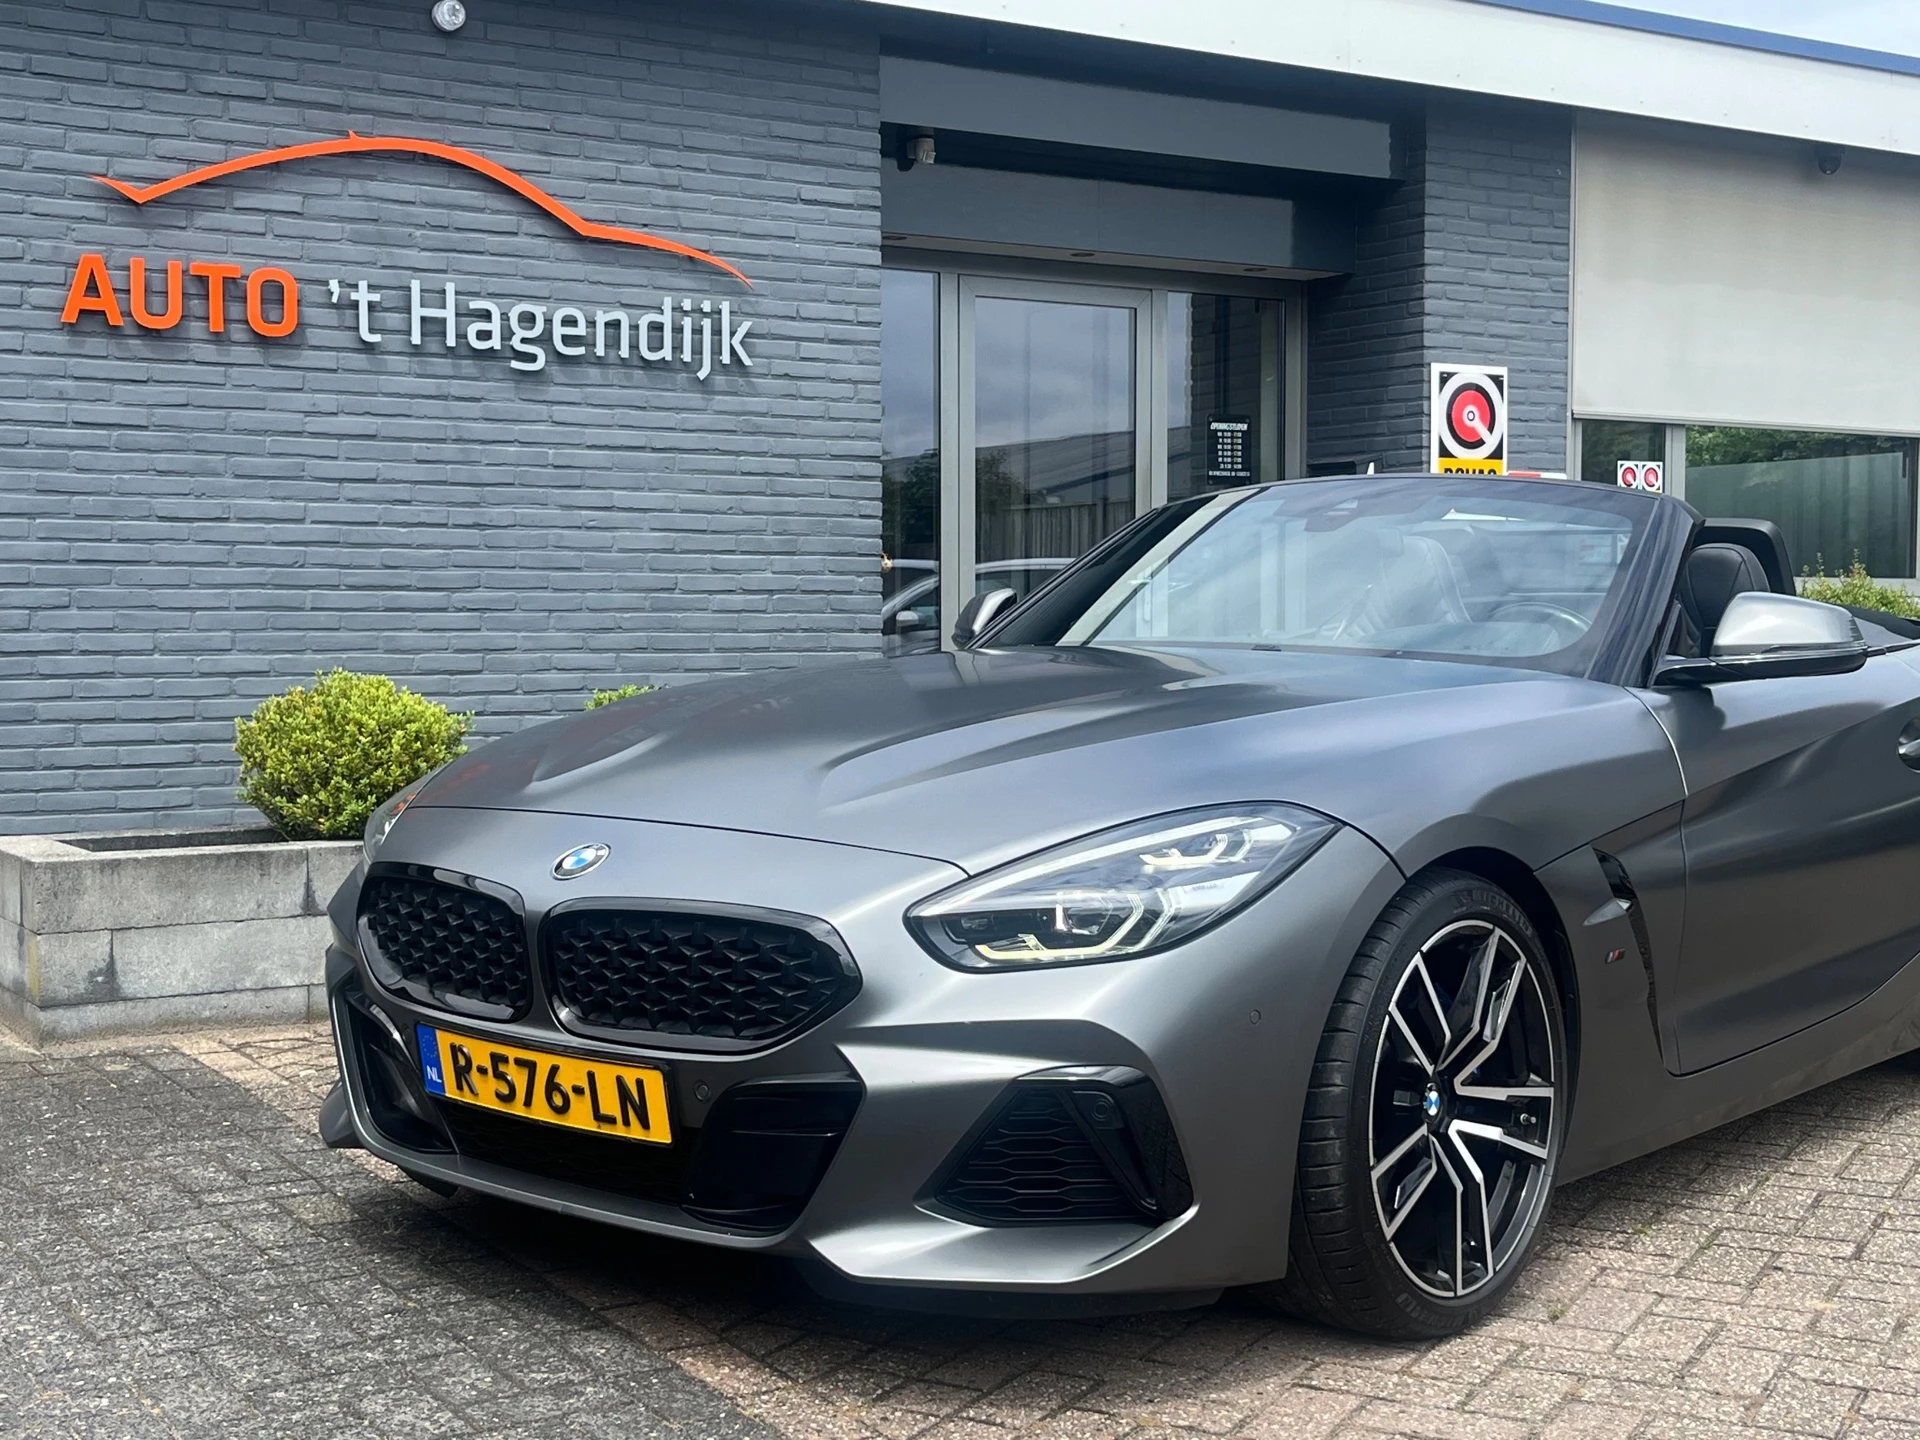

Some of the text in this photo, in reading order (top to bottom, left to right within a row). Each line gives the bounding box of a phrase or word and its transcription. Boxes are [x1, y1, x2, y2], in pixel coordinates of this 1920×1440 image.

[60, 253, 753, 381] AUTO 't Hagendijk
[426, 1065, 442, 1083] NL
[449, 1042, 651, 1130] R-576-LN
